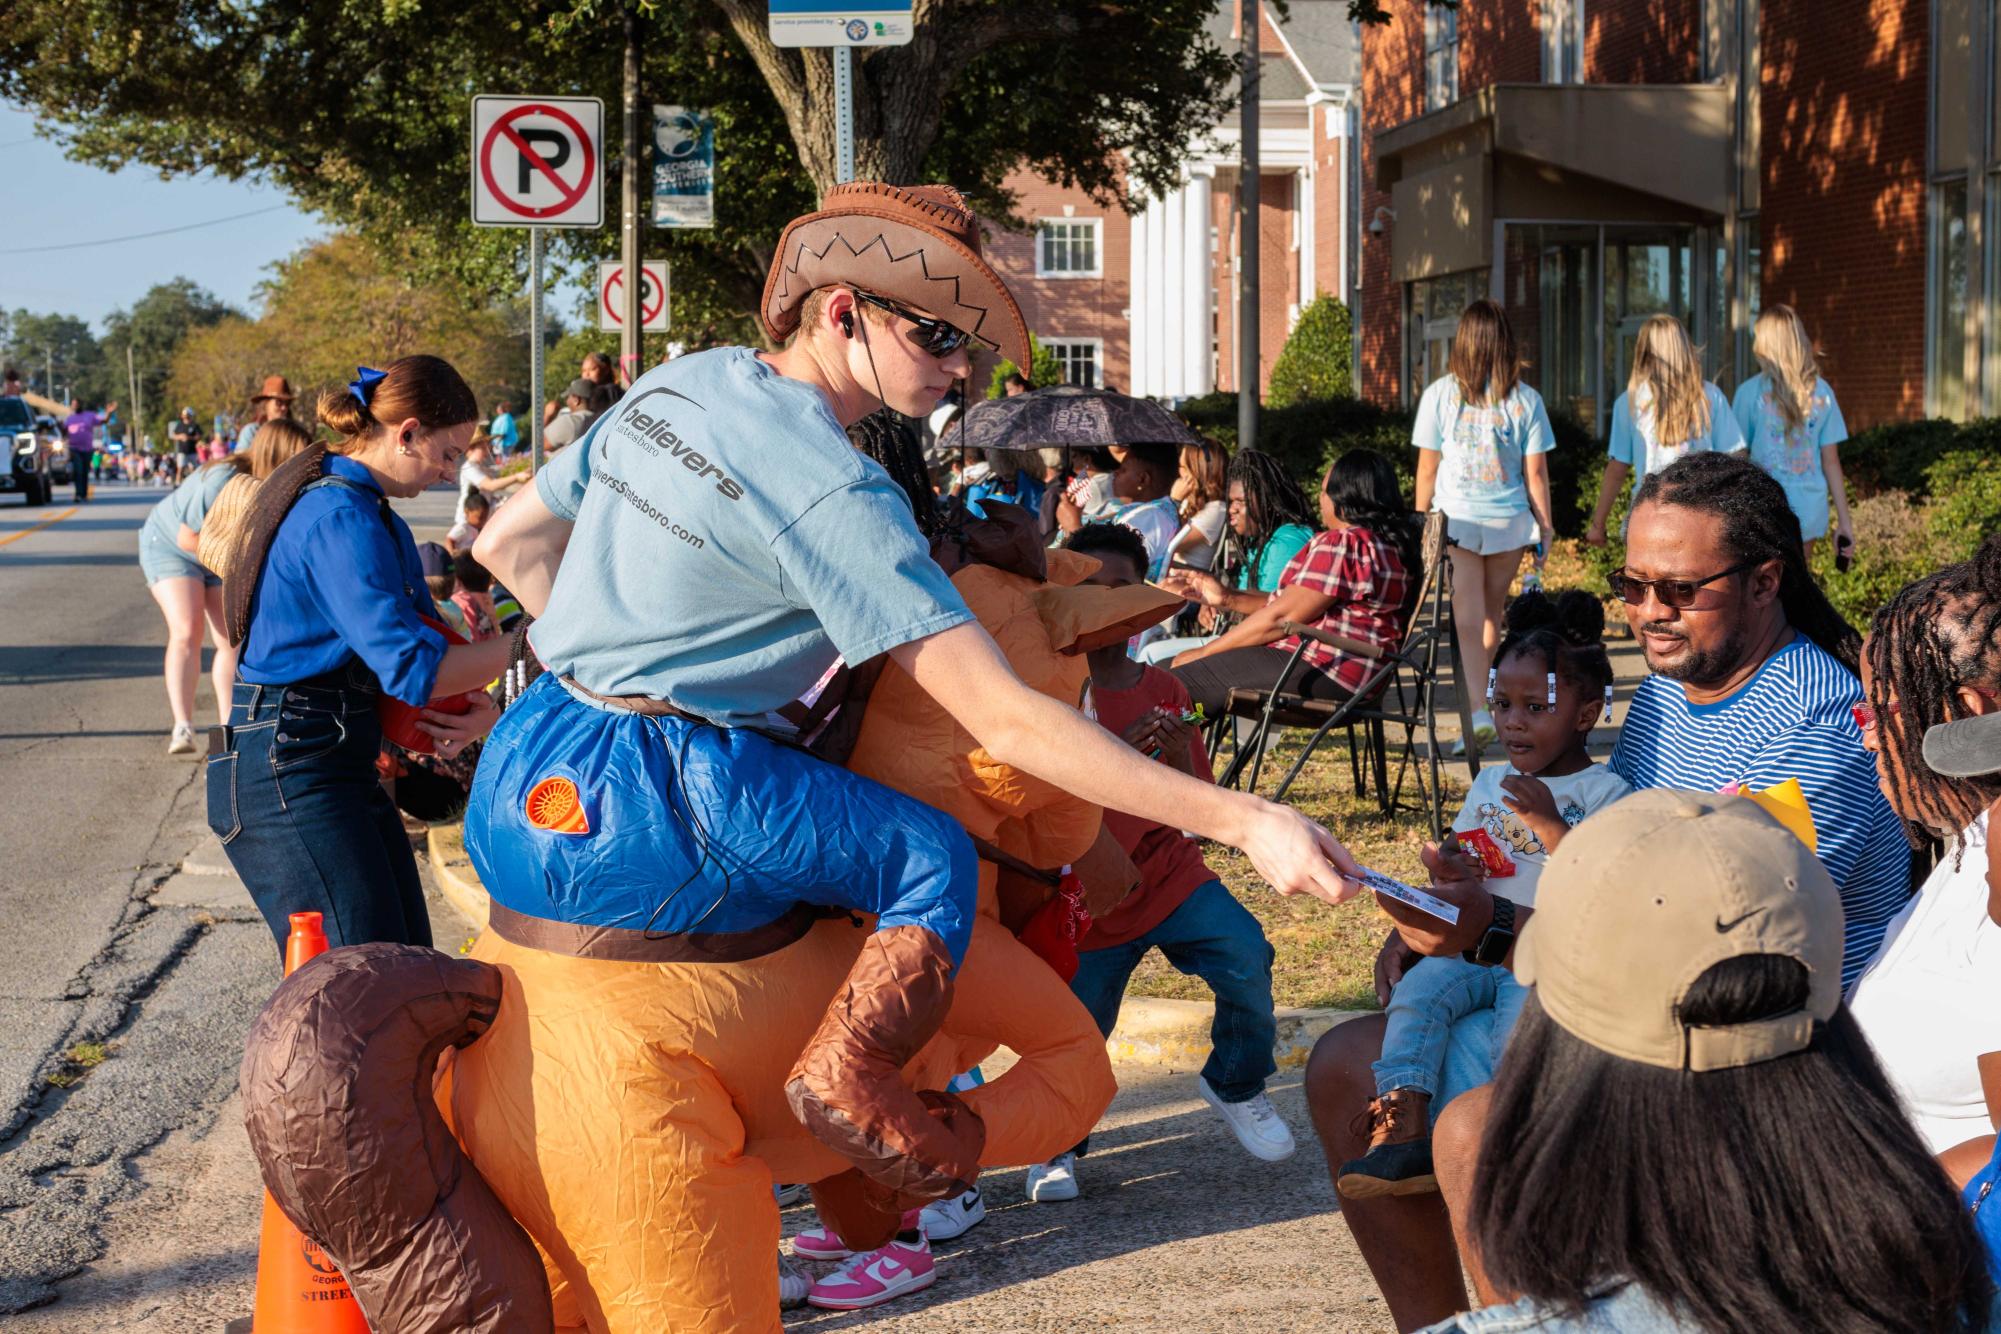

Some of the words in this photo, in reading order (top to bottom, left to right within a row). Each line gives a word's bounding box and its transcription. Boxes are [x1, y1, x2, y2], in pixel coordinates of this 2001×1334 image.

[518, 128, 571, 194] P
[655, 160, 706, 175] GEORGIA
[312, 1274, 345, 1285] GEORG
